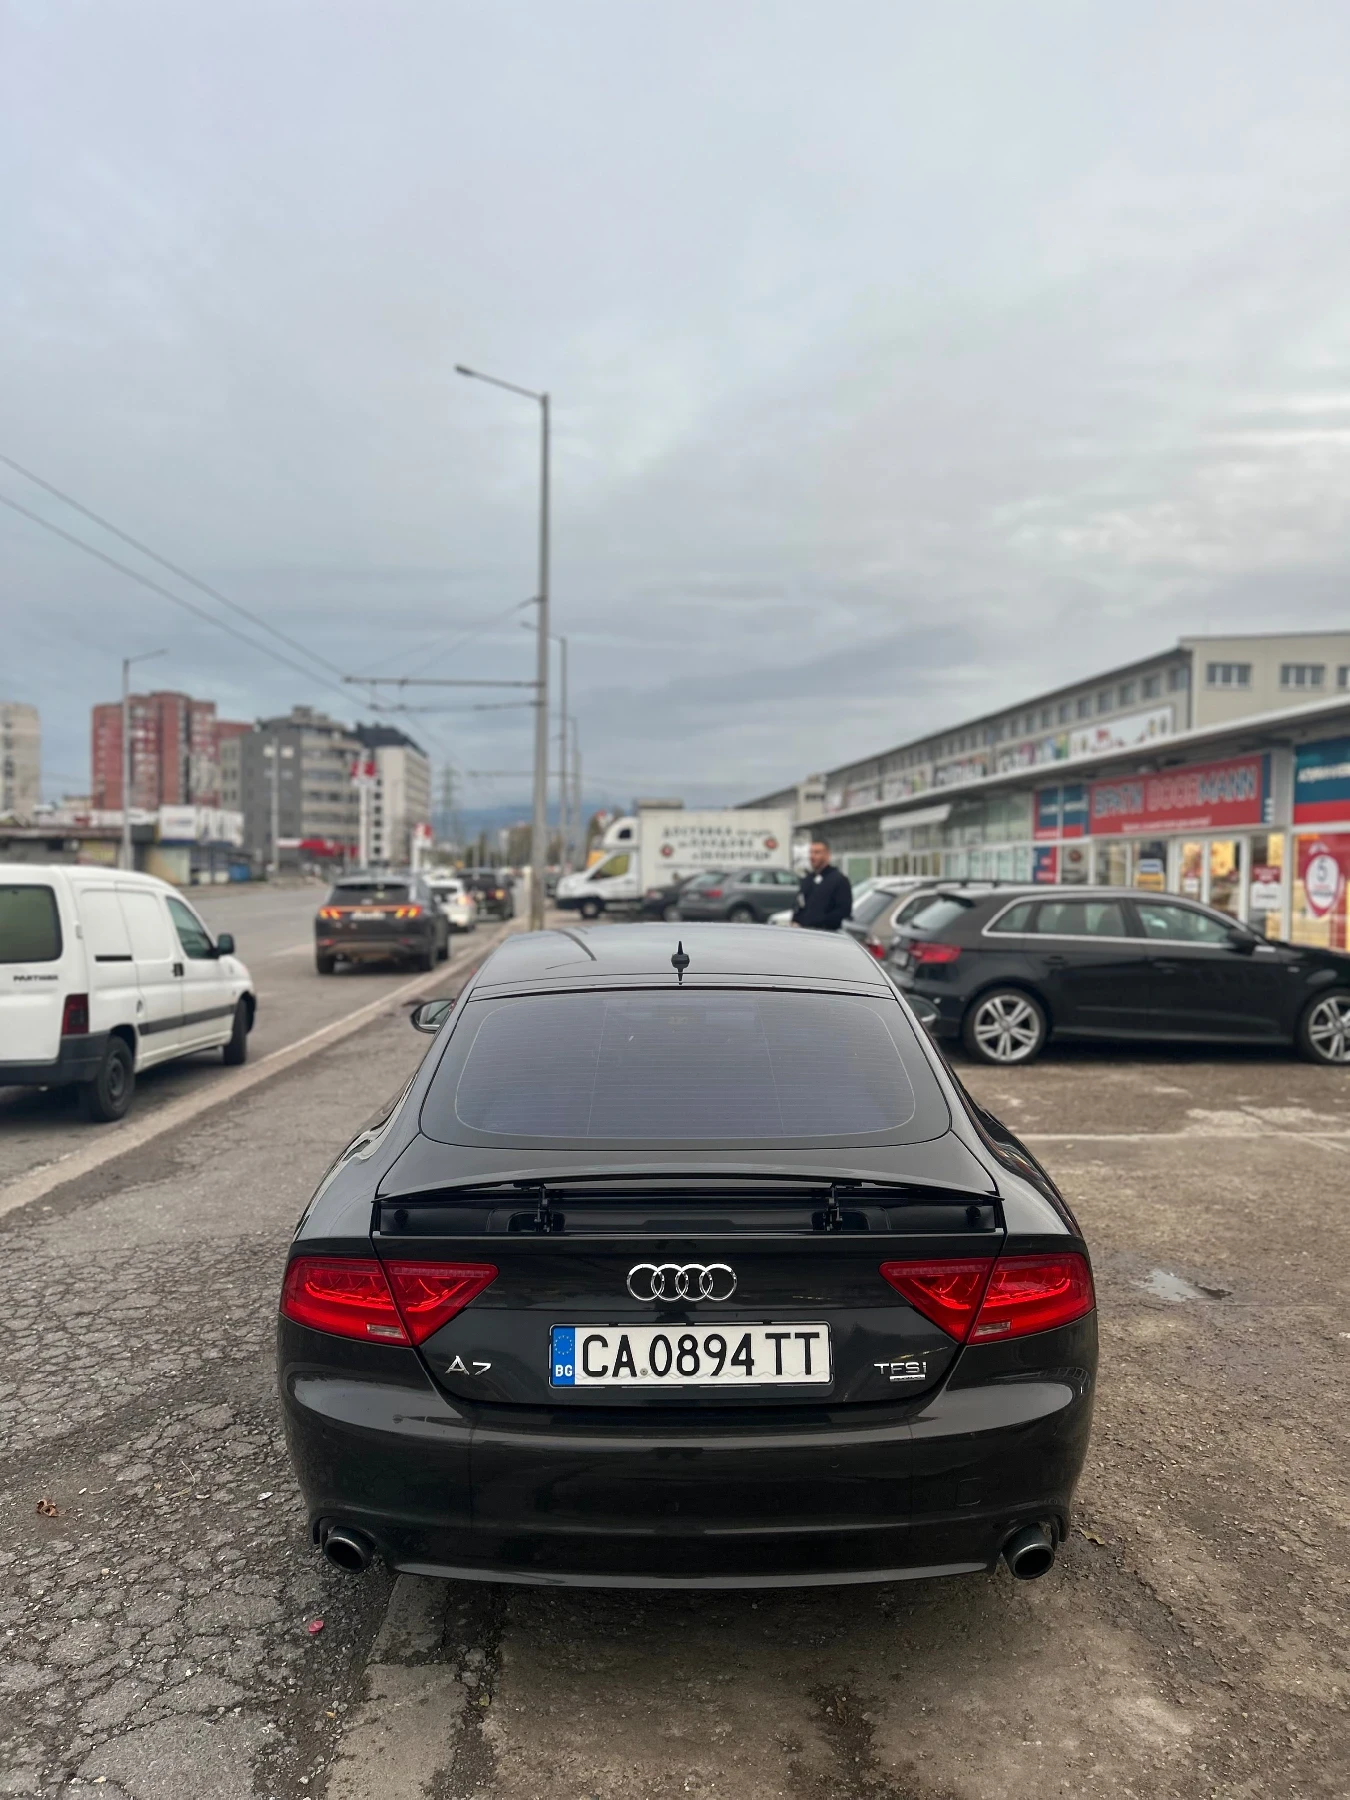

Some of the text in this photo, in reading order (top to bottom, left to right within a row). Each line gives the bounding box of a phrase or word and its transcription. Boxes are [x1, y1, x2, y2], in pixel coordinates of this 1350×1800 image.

[648, 1333, 755, 1377] 0894
[764, 1332, 820, 1376] TT
[445, 1355, 491, 1375] A7
[555, 1364, 573, 1377] BG
[873, 1361, 927, 1374] TFSI
